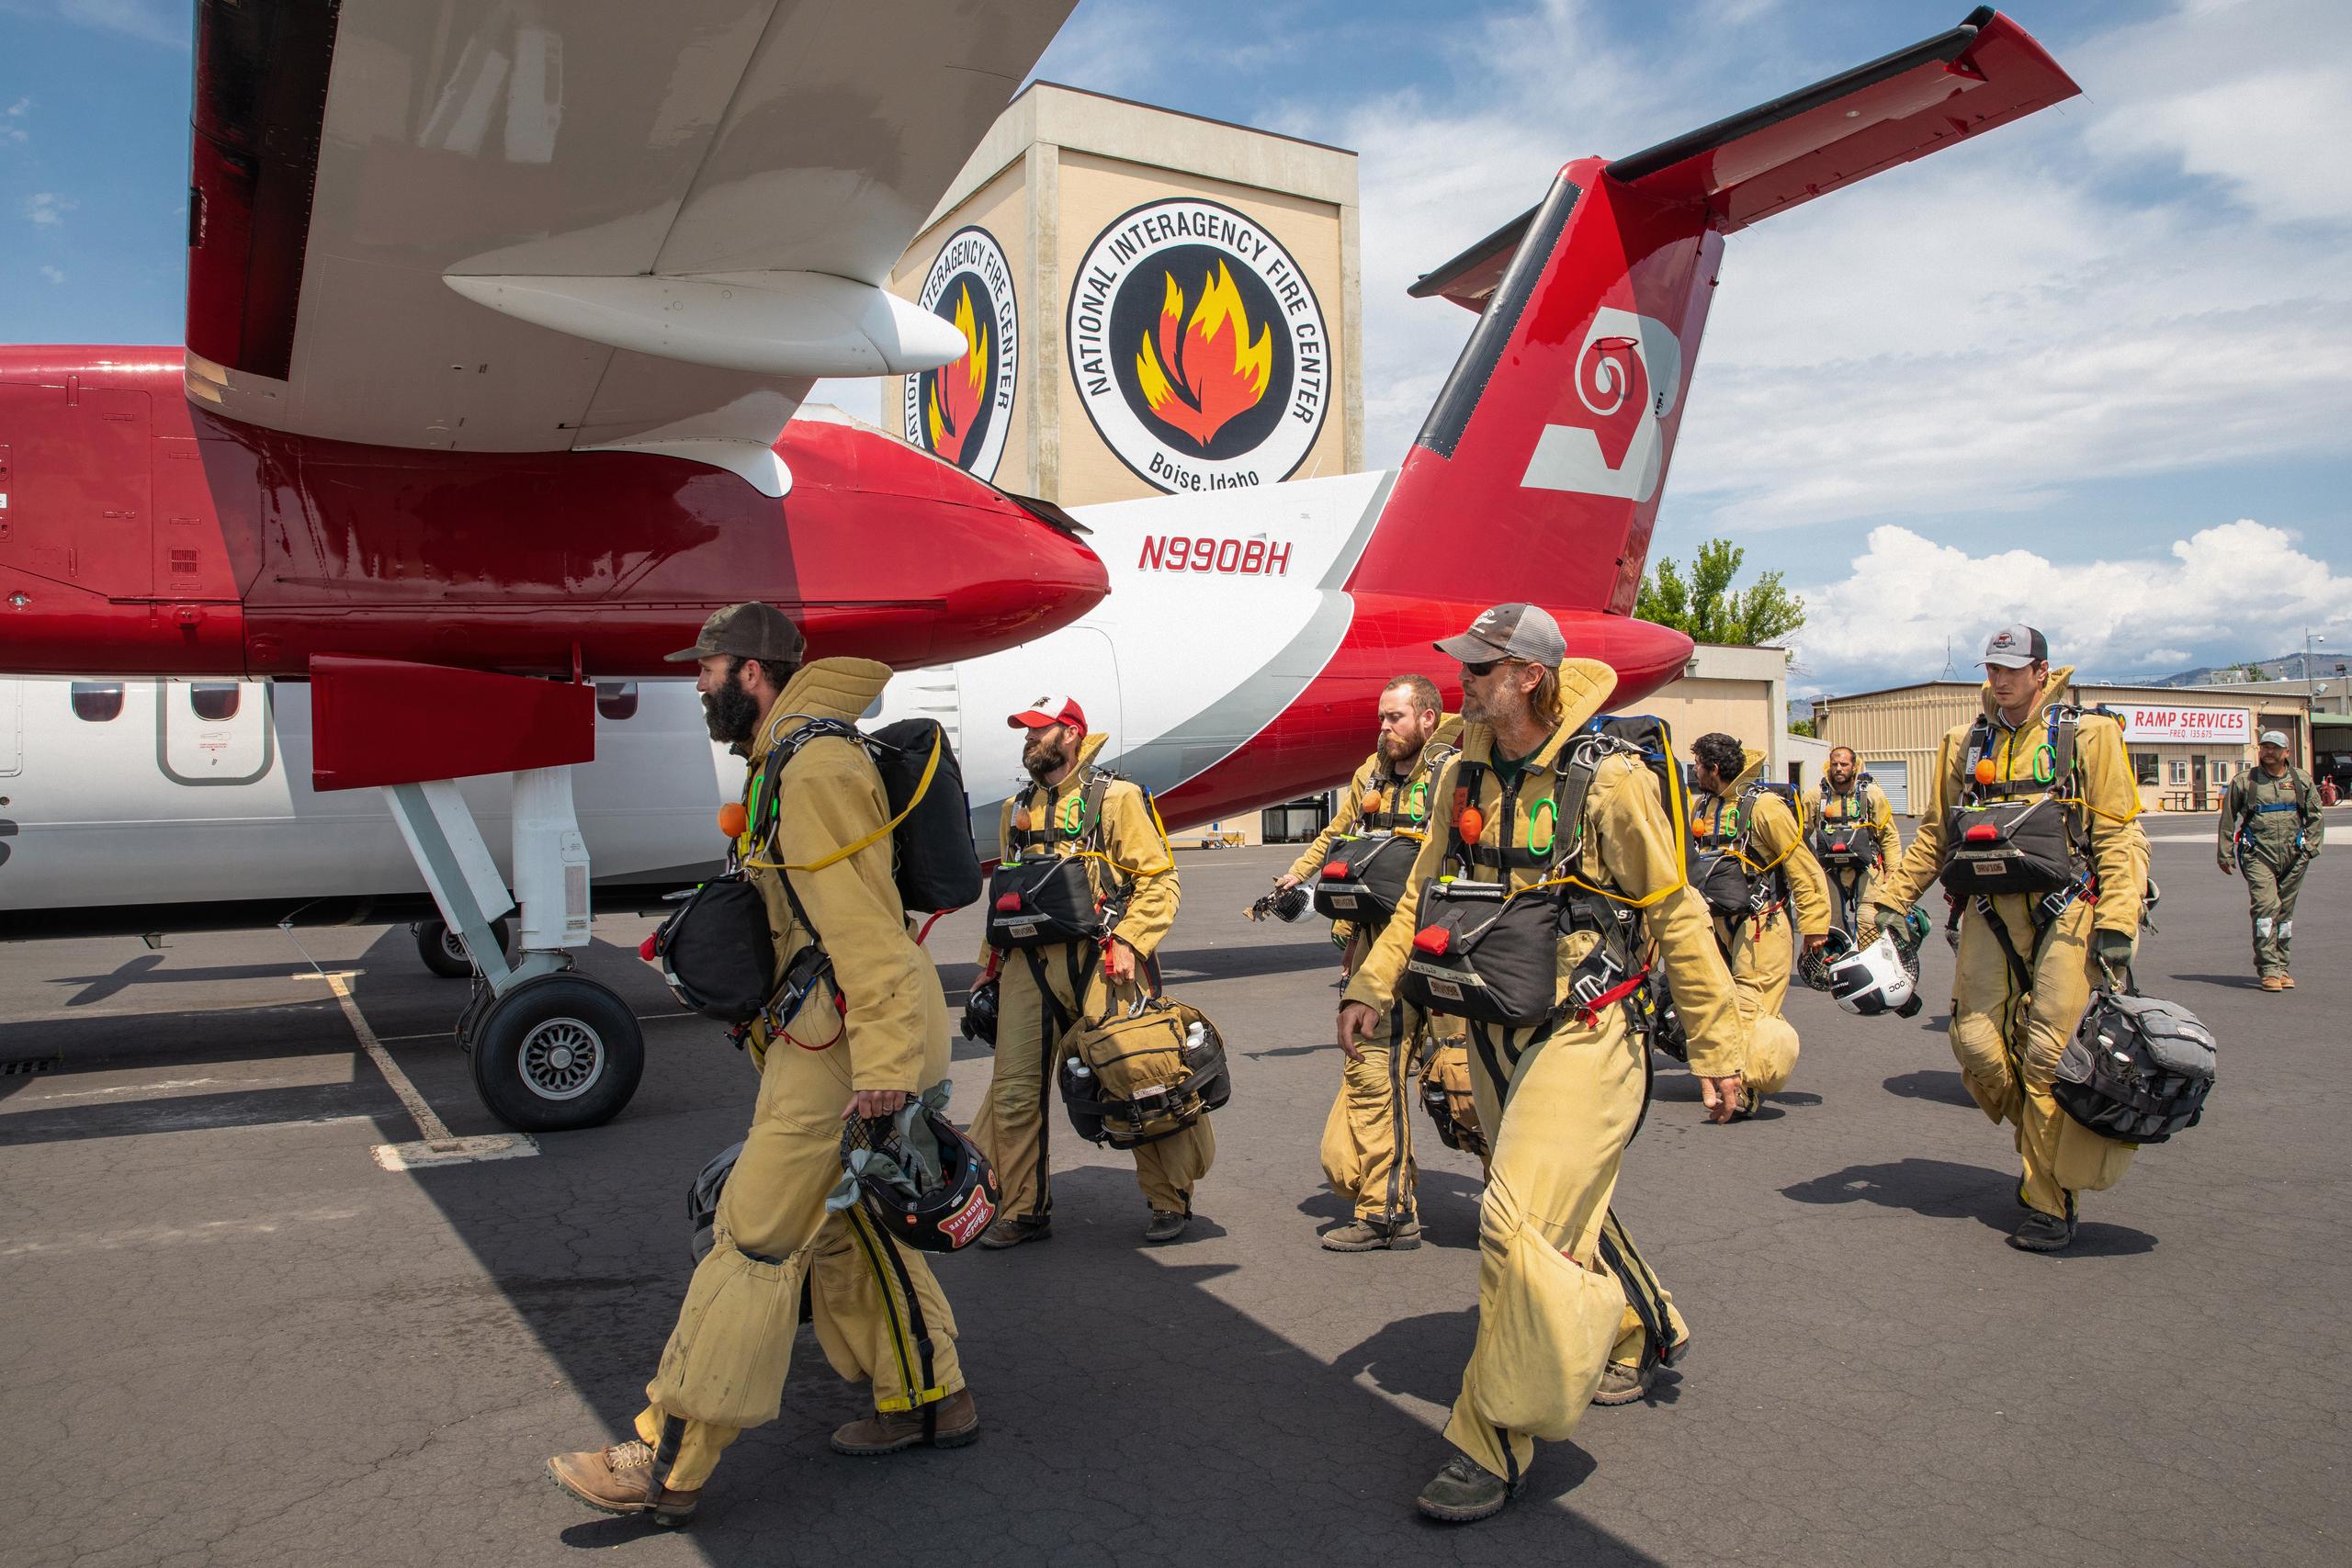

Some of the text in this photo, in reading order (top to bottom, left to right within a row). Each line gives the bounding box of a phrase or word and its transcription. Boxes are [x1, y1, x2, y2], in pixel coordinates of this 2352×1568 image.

[1079, 211, 1320, 424] NATIONAL INTERAGENCY FIRE CENTER
[984, 252, 1006, 303] FIRE
[998, 300, 1013, 411] CENTER
[1210, 470, 1259, 491] Idaho
[1138, 536, 1292, 575] N990BH
[2135, 711, 2243, 728] RAMP SERVICES
[2169, 729, 2188, 738] FREQ.
[1975, 864, 2003, 873] 9RV106
[967, 1197, 983, 1218] HIGH
[949, 1216, 967, 1231] LIFE
[960, 1208, 988, 1243] Boise
